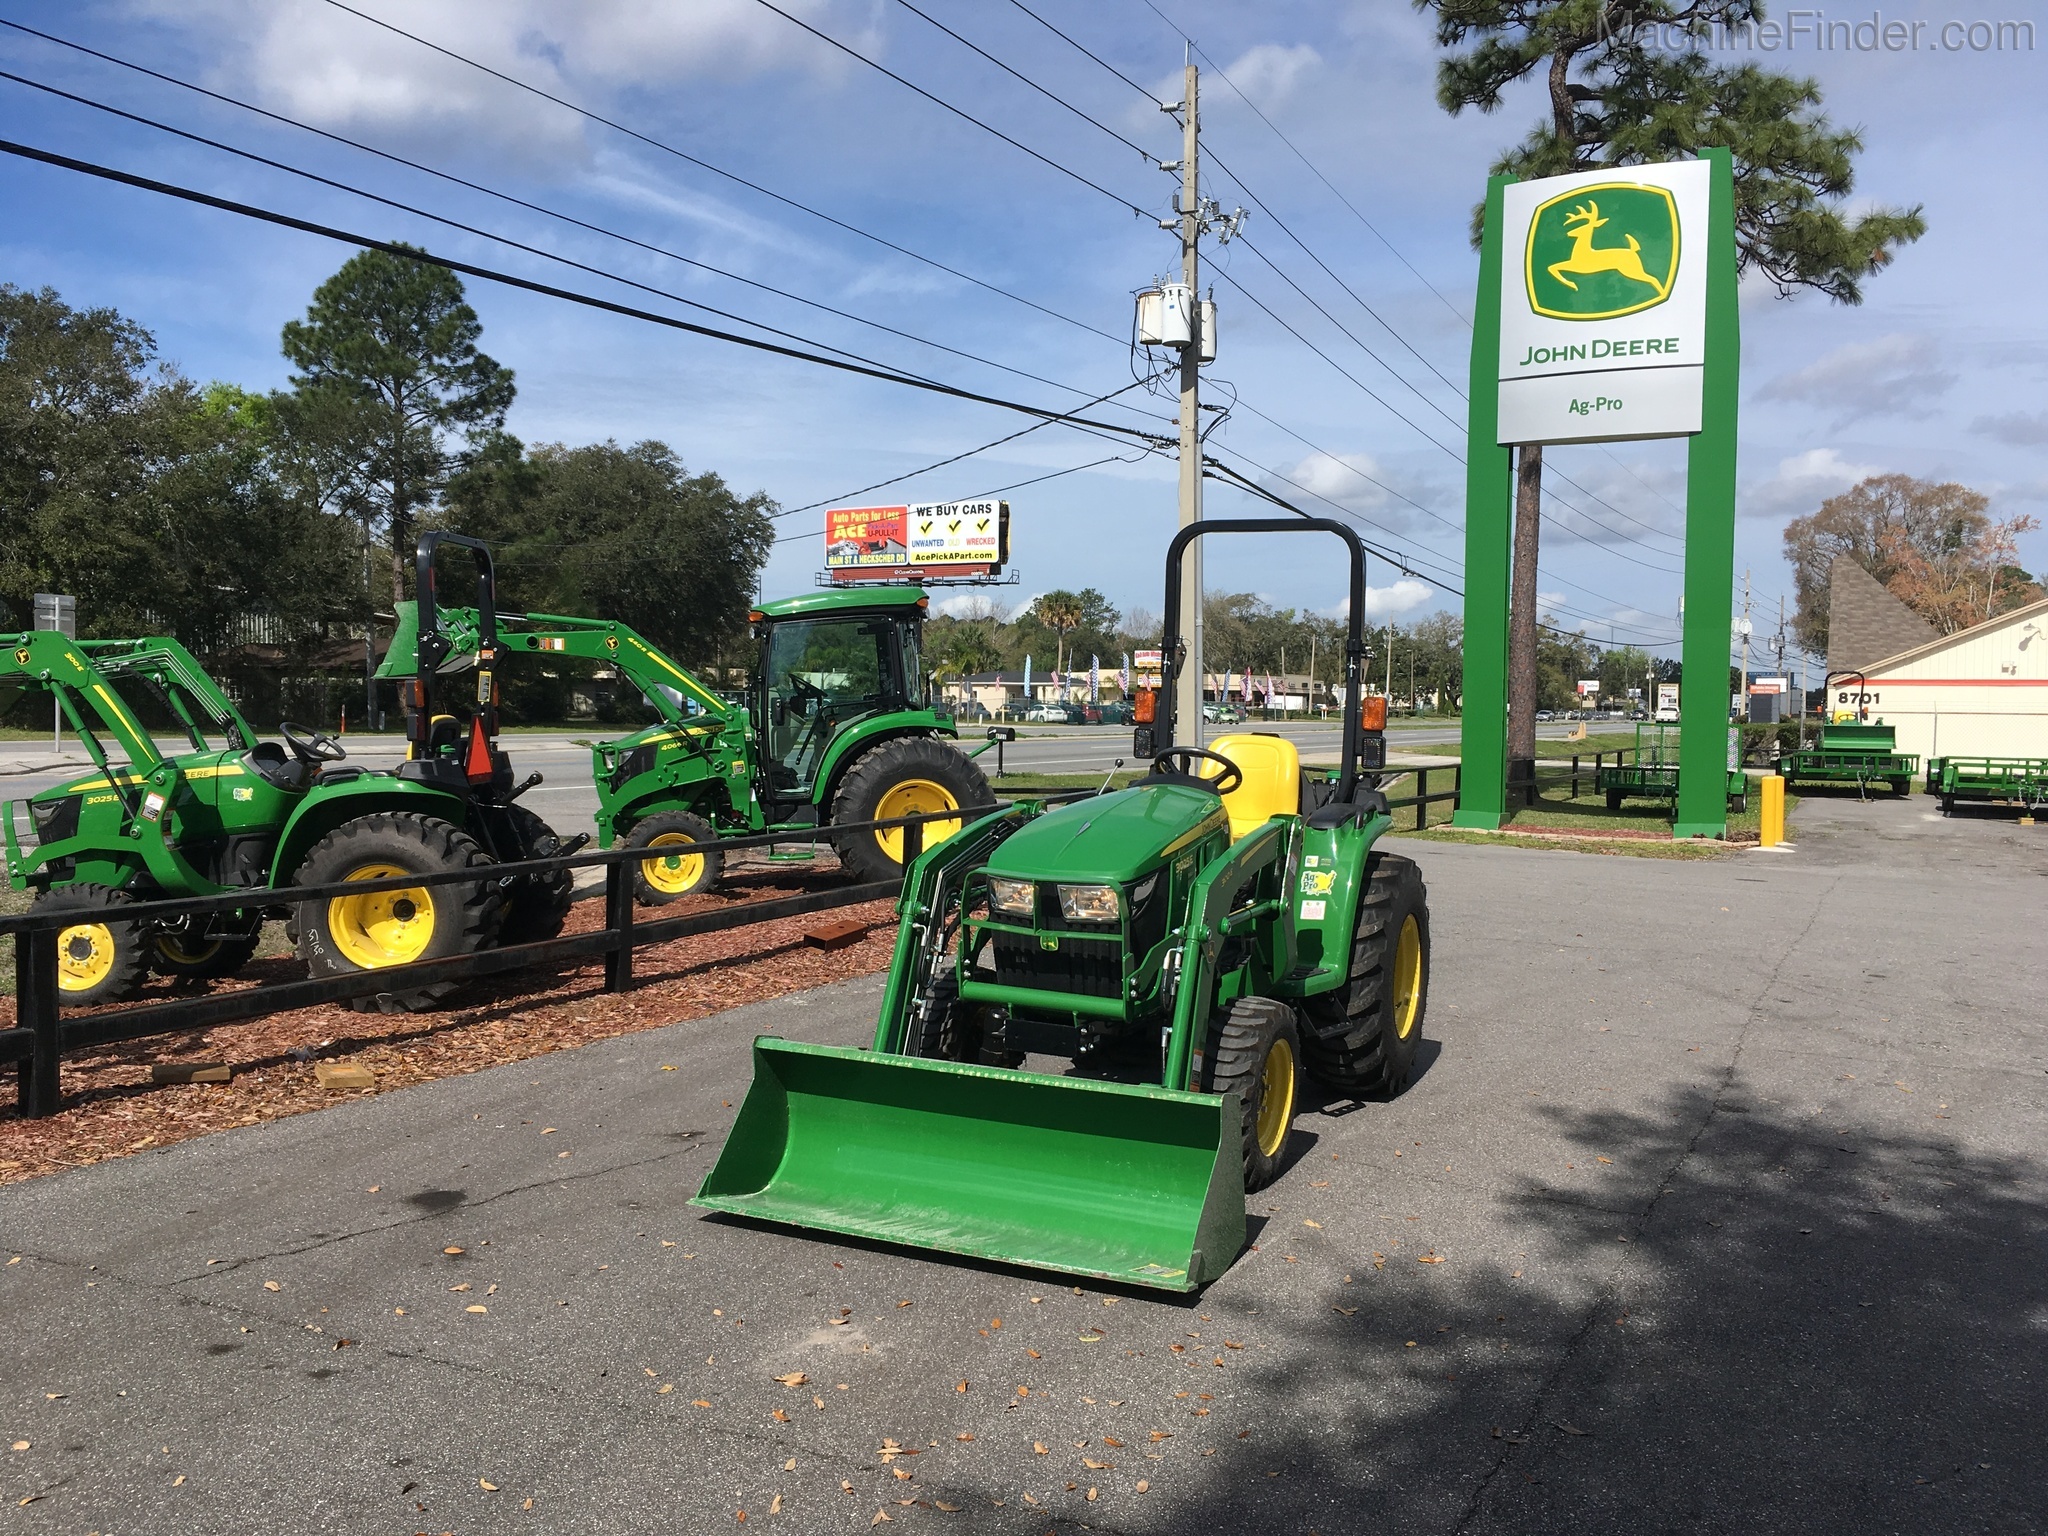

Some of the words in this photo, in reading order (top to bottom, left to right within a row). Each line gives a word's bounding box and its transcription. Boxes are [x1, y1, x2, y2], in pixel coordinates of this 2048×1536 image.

[1519, 343, 1586, 366] JOHN
[1591, 337, 1680, 359] DEERE
[1568, 396, 1623, 415] Ag-Pro
[833, 512, 849, 523] Auto
[851, 511, 870, 523] Parts
[871, 510, 881, 521] for
[883, 509, 900, 521] Less
[916, 506, 932, 517] WE
[936, 505, 958, 516] BUY
[962, 503, 992, 515] CARS
[834, 523, 867, 539] ACE
[868, 529, 899, 537] U-PULL-IT
[911, 538, 945, 548] UNWANTED
[947, 538, 960, 547] OLD
[966, 537, 996, 546] WRECKED
[828, 555, 844, 565] MAIN
[845, 555, 853, 564] ST
[853, 554, 858, 564] &
[859, 553, 896, 564] HECKSCHER
[896, 553, 906, 563] DR
[915, 552, 993, 561] AcePickAPart.com
[1838, 692, 1881, 704] 8701
[87, 795, 121, 804] 3025E
[1303, 881, 1319, 890] Pro
